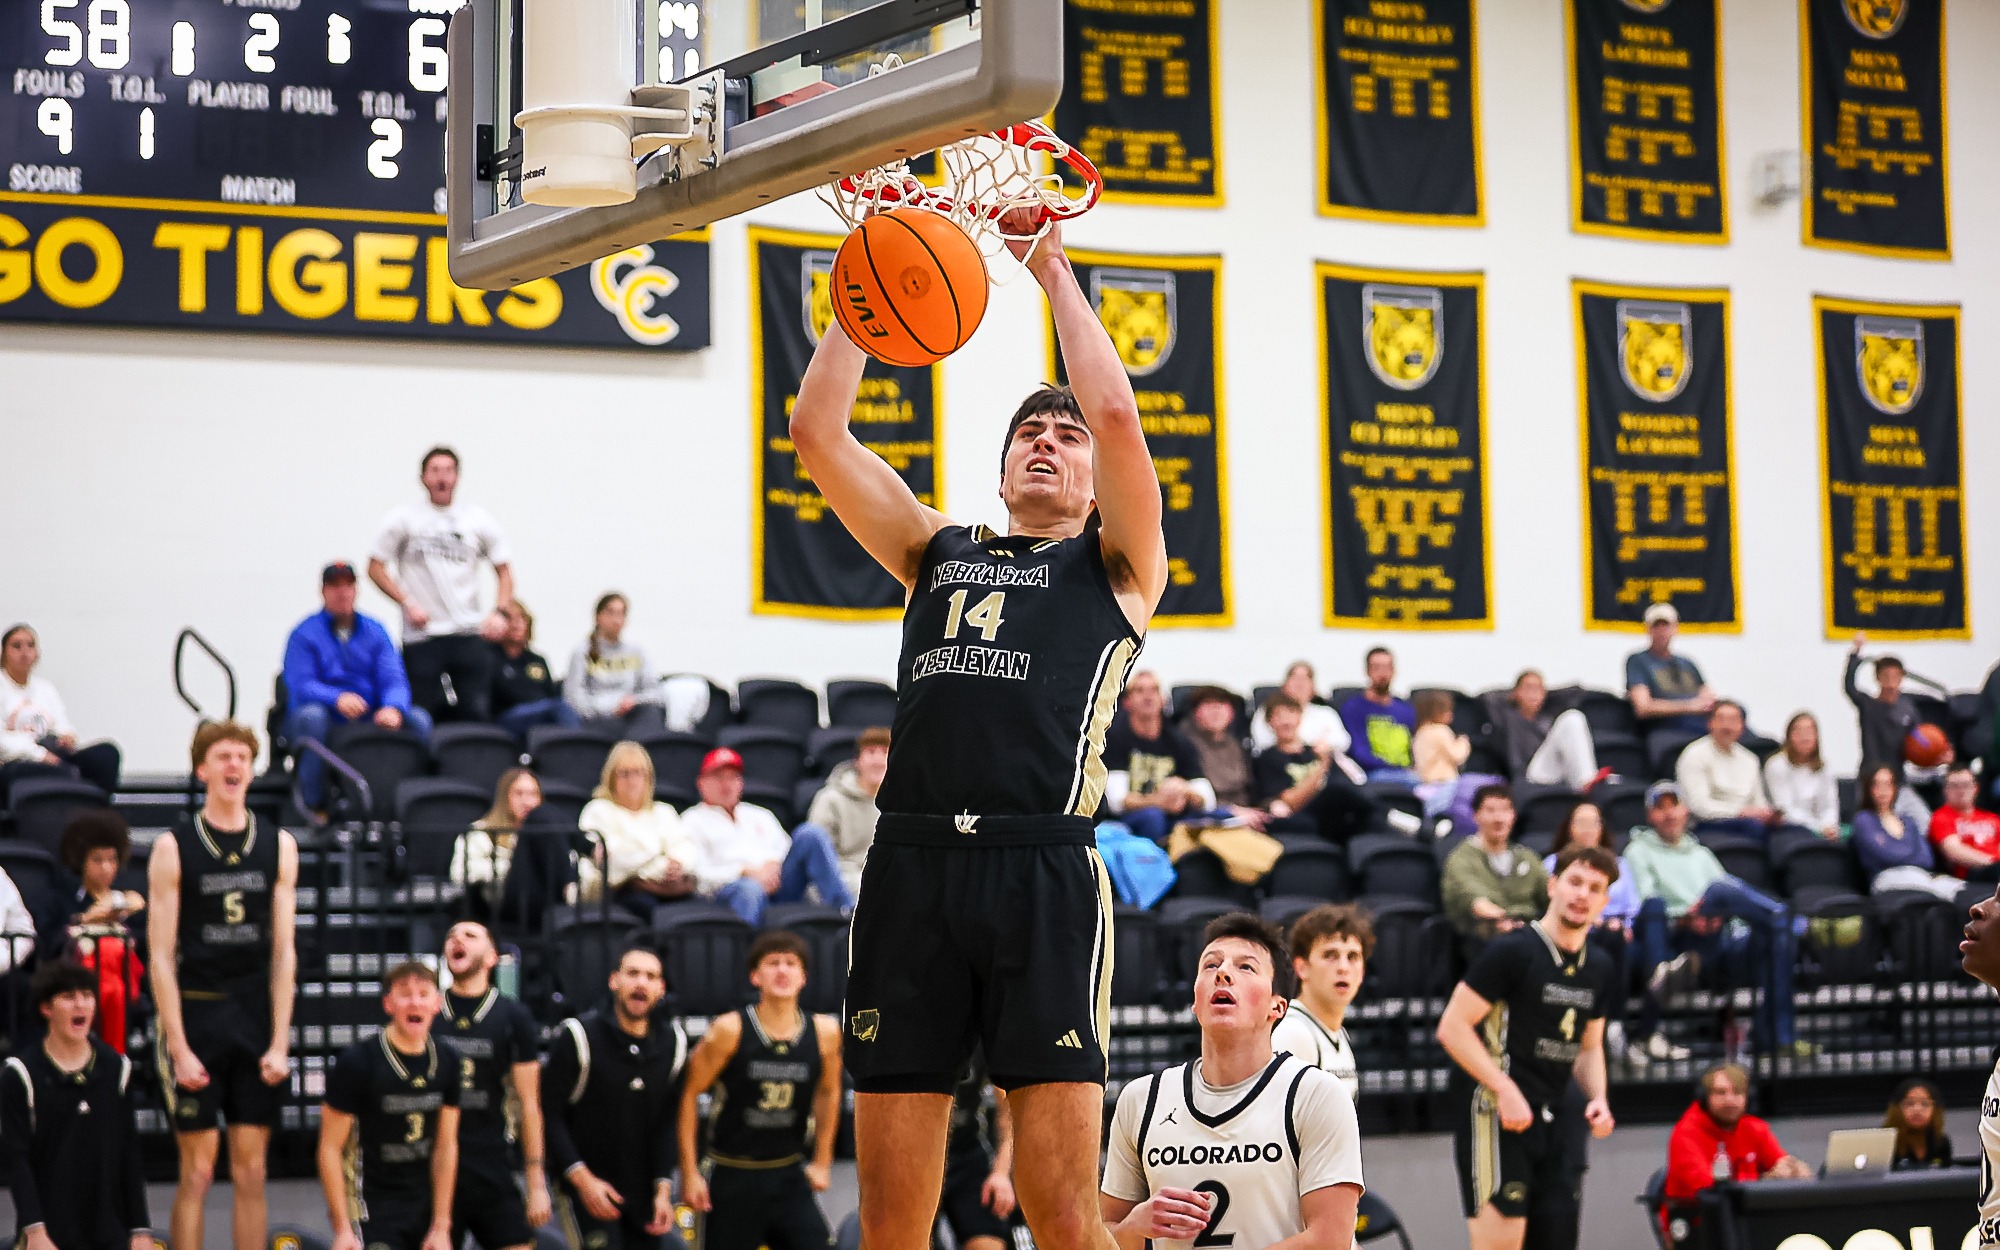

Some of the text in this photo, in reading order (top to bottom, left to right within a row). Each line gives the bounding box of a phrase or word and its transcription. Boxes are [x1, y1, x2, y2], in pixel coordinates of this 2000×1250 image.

[40, 0, 130, 70] 58
[244, 12, 280, 73] 2
[13, 68, 86, 98] FOULS
[188, 79, 271, 112] PLAYER
[280, 85, 338, 116] FOUL
[37, 97, 73, 155] 9
[139, 106, 155, 160] 1
[367, 117, 403, 179] 2
[9, 163, 83, 194] SCORE
[221, 174, 296, 206] MATCH
[930, 561, 1049, 593] NEBRASKA
[944, 589, 1005, 642] 14
[912, 646, 1031, 682] WESLEYAN
[223, 890, 246, 924] 5
[1559, 1007, 1577, 1041] 4
[758, 1081, 795, 1111] 30
[404, 1111, 425, 1144] 3
[1147, 1142, 1283, 1168] COLORADO
[1192, 1179, 1236, 1249] 2
